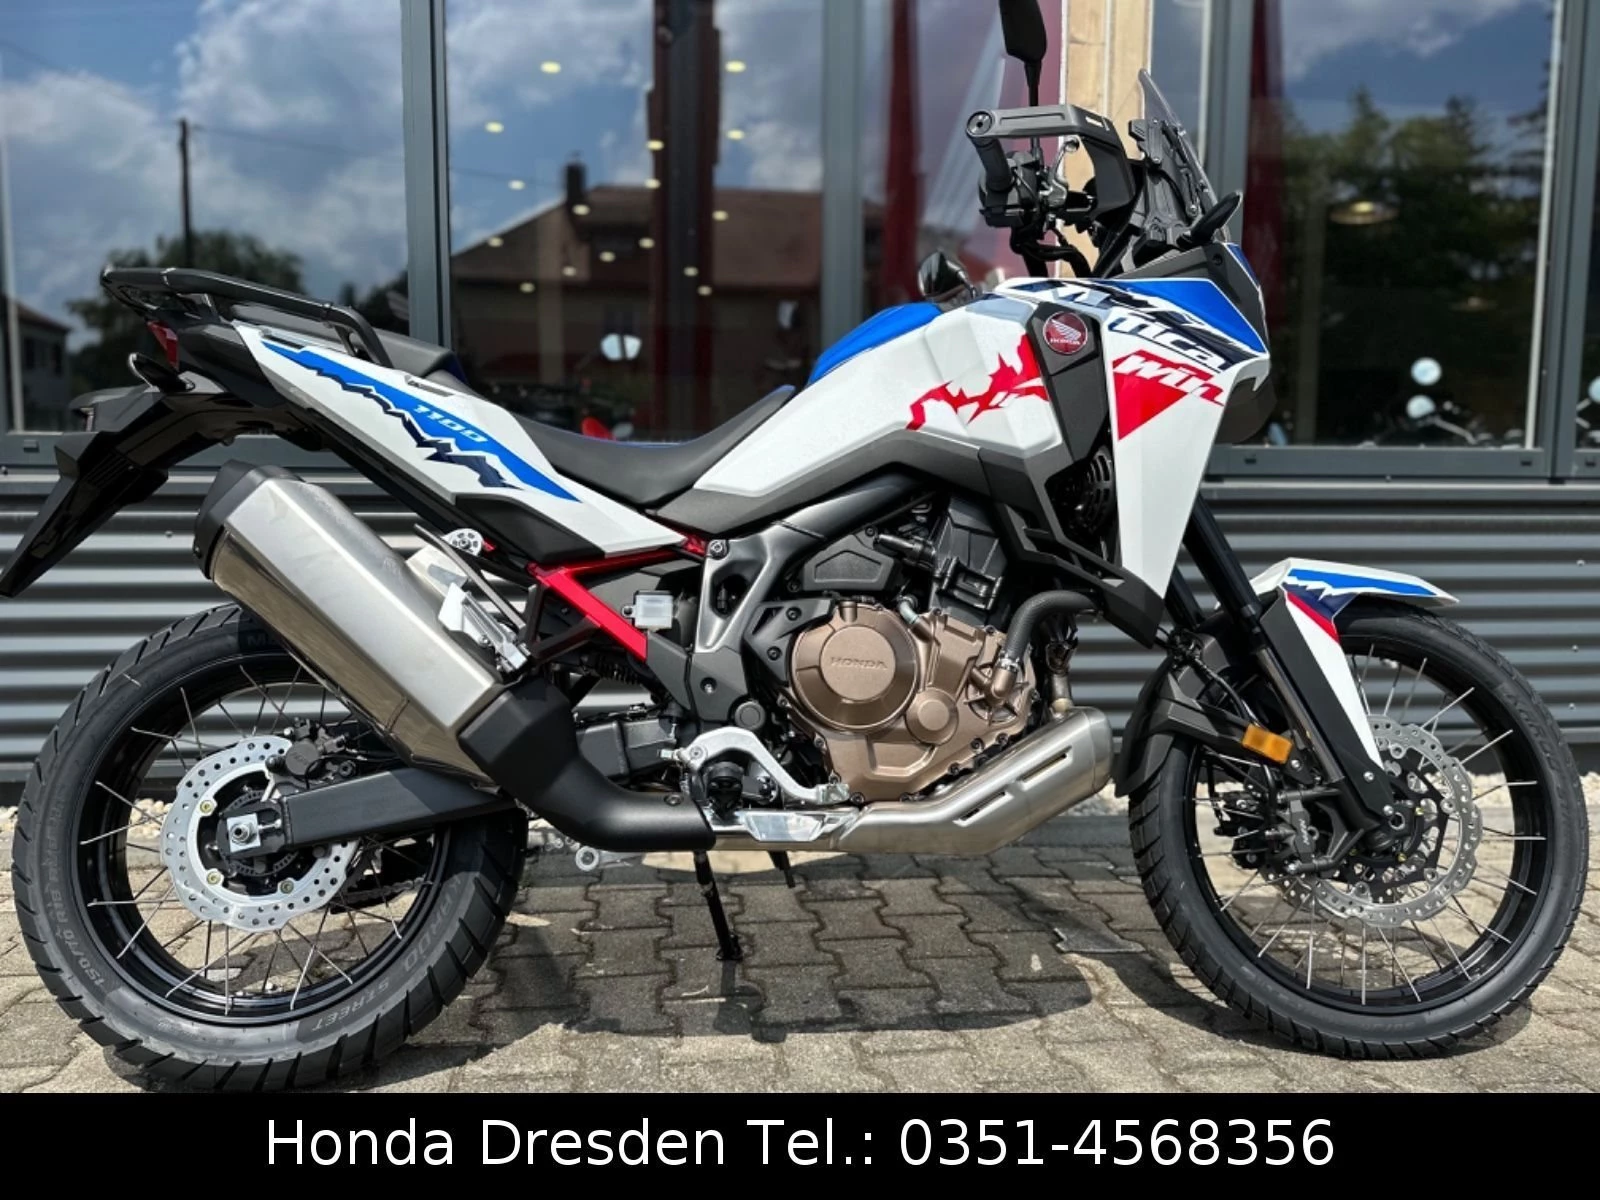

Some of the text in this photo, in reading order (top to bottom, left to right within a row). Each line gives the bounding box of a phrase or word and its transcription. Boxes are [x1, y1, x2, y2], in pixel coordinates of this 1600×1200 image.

[413, 404, 488, 442] 1100
[830, 656, 888, 671] HONDA
[311, 980, 391, 1032] STREET
